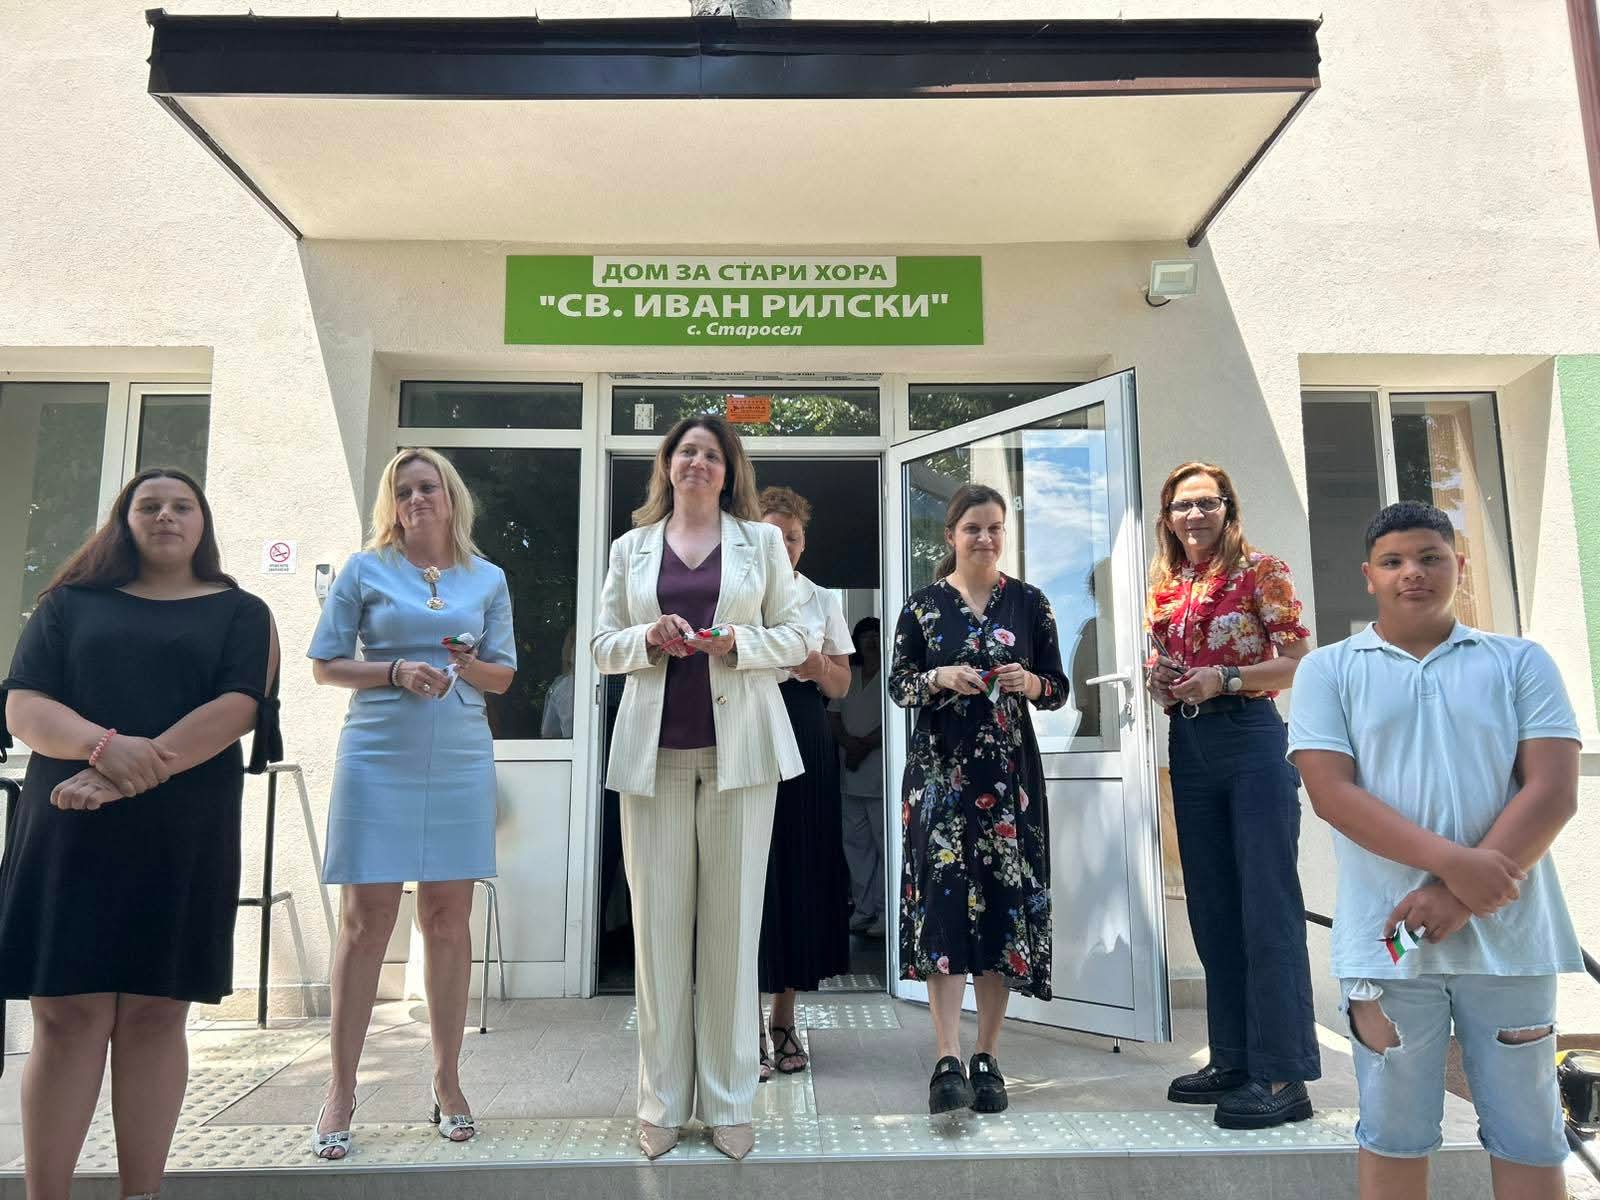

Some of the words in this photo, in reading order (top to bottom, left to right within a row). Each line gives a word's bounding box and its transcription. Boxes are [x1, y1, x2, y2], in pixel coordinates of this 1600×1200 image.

[602, 264, 668, 283] ДОМ
[676, 264, 711, 281] ЗА
[718, 264, 807, 281] СТАРИ
[814, 264, 888, 281] ХОРА
[539, 294, 623, 318] "СВ.
[634, 294, 750, 318] ИВАН
[763, 293, 949, 318] РИЛСКИ"
[687, 325, 702, 336] с.
[706, 322, 803, 338] Старосел
